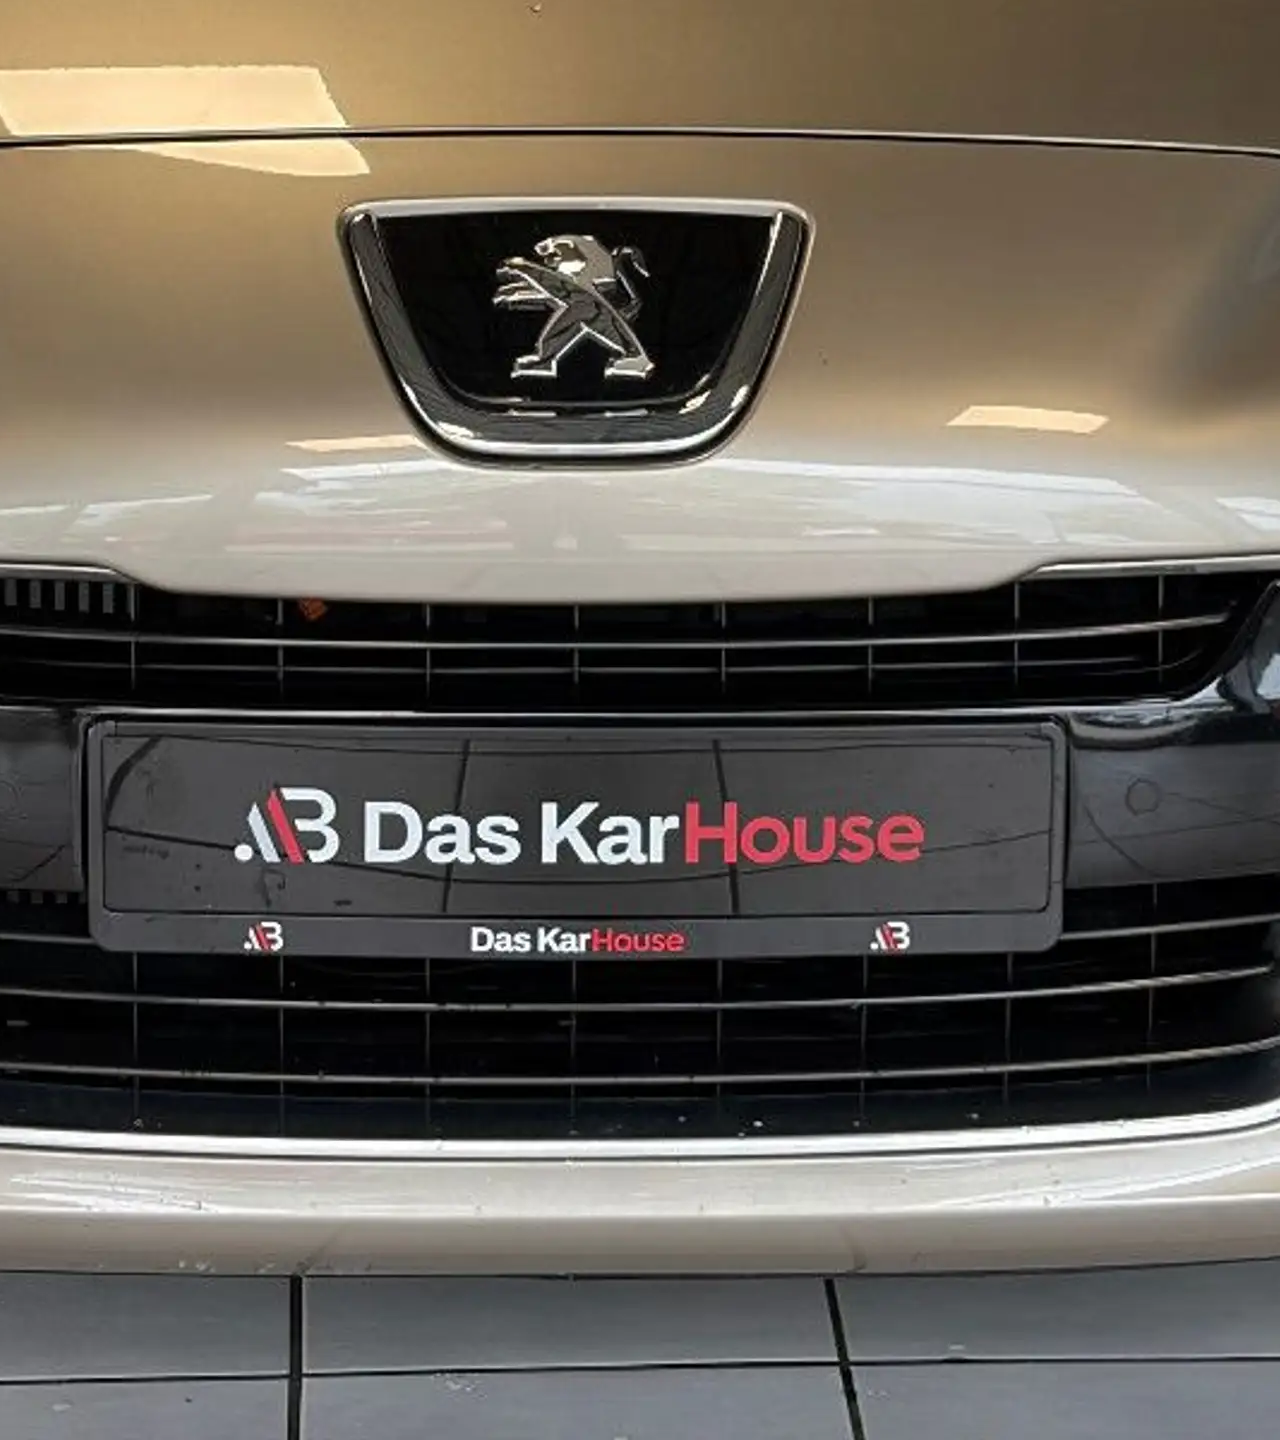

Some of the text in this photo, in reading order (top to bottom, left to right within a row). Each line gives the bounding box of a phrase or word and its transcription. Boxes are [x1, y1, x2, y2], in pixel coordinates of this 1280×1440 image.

[364, 801, 521, 864] Das
[540, 801, 925, 864] KarHouse
[470, 926, 531, 953] Das
[536, 926, 686, 953] KarHouse
